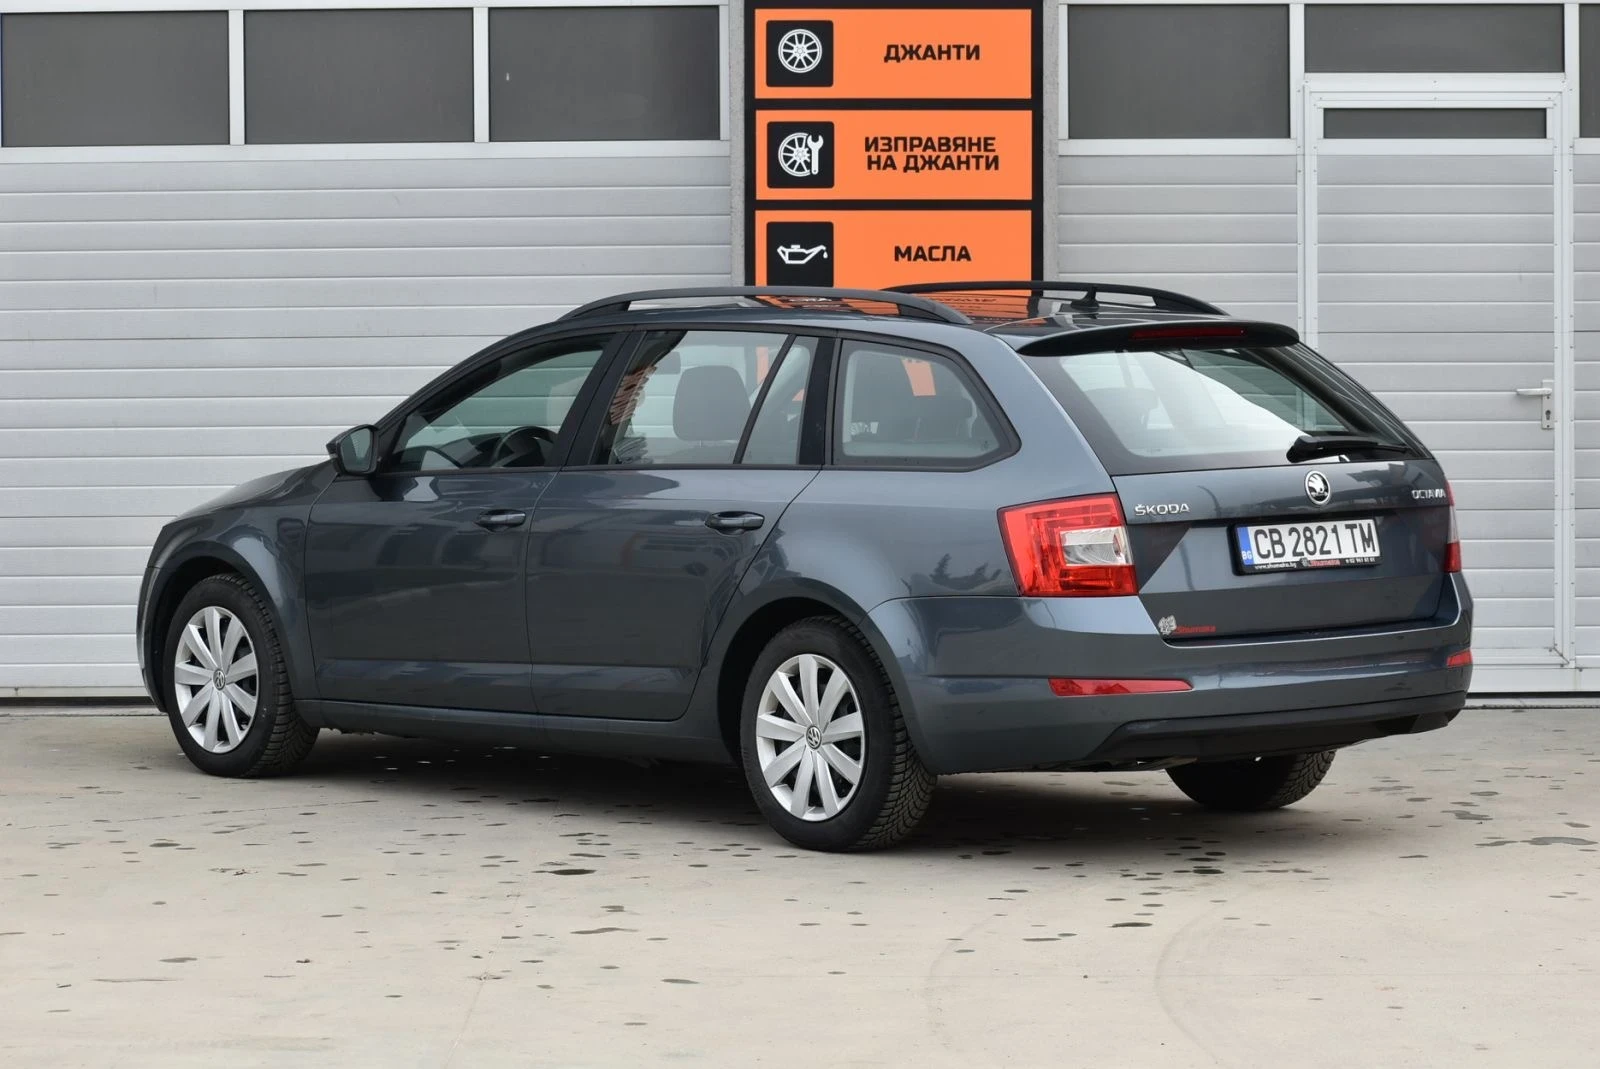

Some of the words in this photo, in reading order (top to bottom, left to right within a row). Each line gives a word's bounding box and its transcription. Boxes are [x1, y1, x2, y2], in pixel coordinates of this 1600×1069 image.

[884, 44, 980, 63] ДЖАНТИ
[865, 137, 995, 152] ИЗПРАВЯНЕ
[867, 155, 897, 170] НА
[903, 155, 999, 173] ДЖАНТИ
[895, 246, 971, 261] МАСЛА
[1134, 503, 1190, 516] ŠKODA
[1254, 529, 1286, 558] CB
[1289, 525, 1342, 557] 2821
[1344, 523, 1376, 553] TM
[1241, 550, 1253, 560] BG
